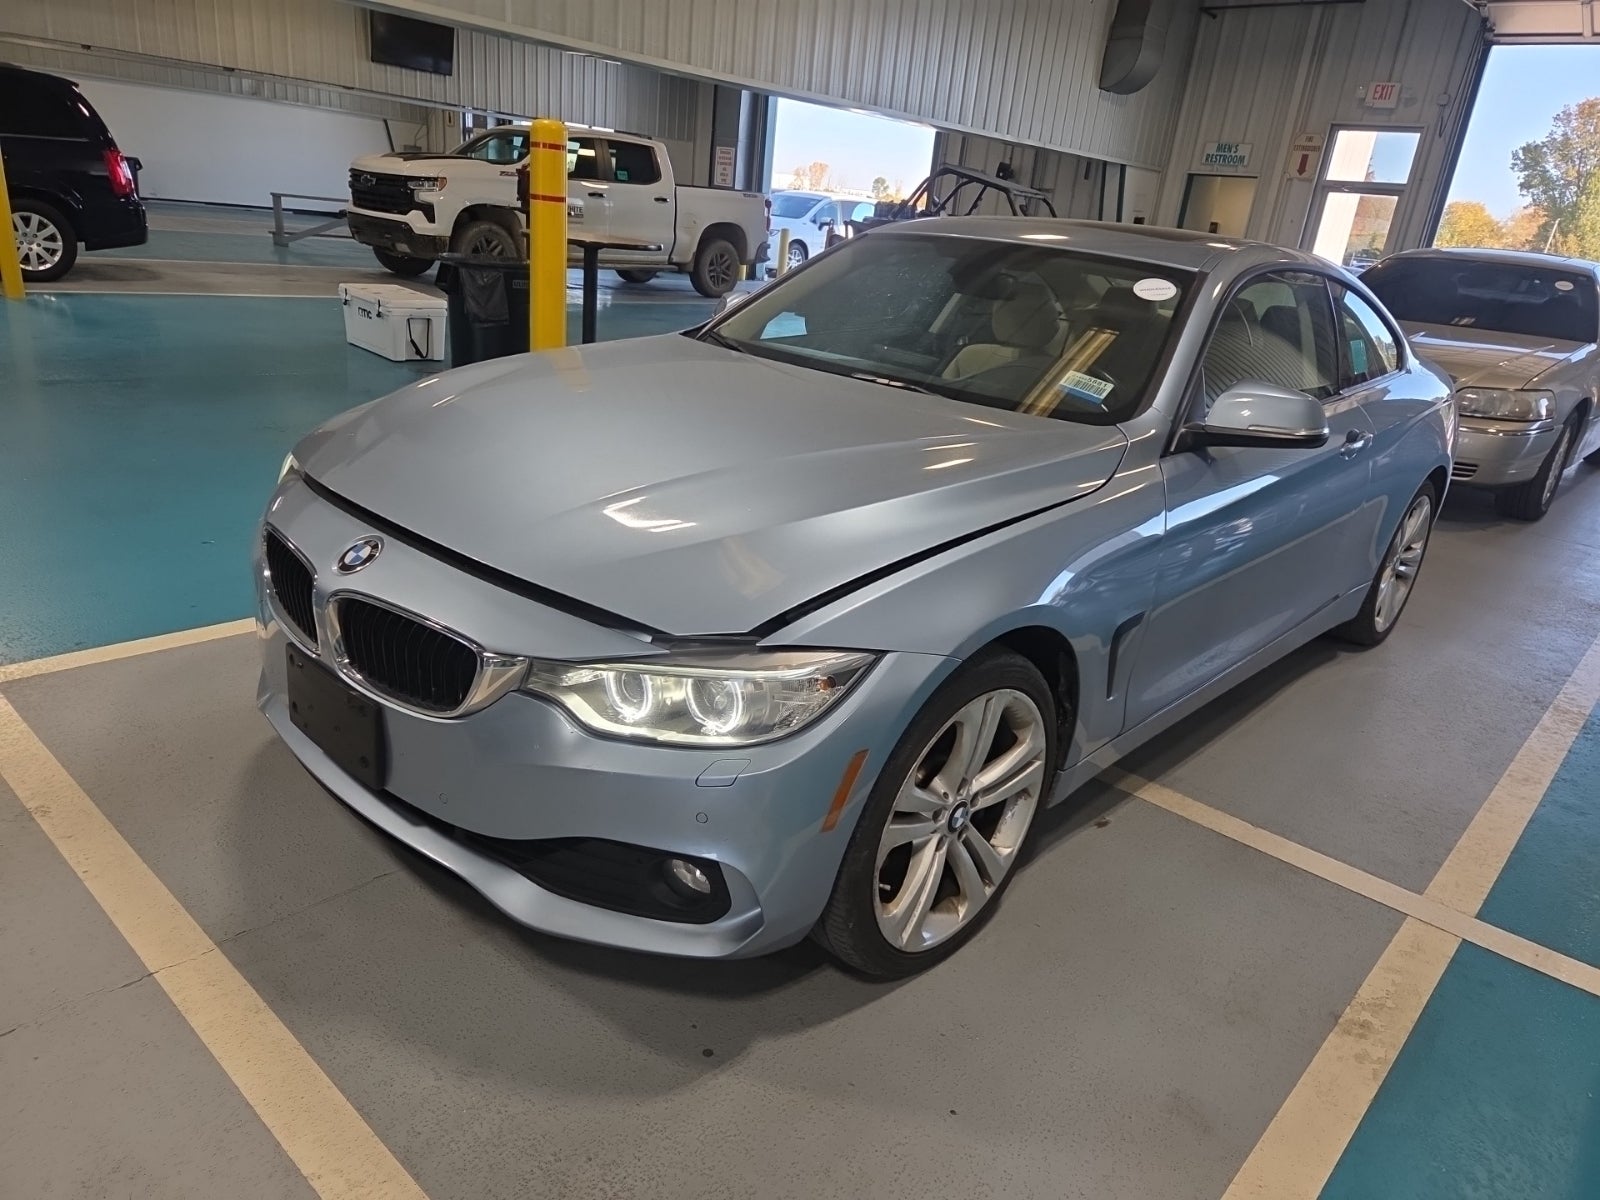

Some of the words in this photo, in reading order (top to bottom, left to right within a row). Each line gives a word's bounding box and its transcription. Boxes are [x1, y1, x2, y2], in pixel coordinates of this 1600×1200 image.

[1372, 84, 1396, 101] EXIT
[1215, 143, 1240, 154] MEN'S
[1204, 153, 1246, 165] RESTROOM
